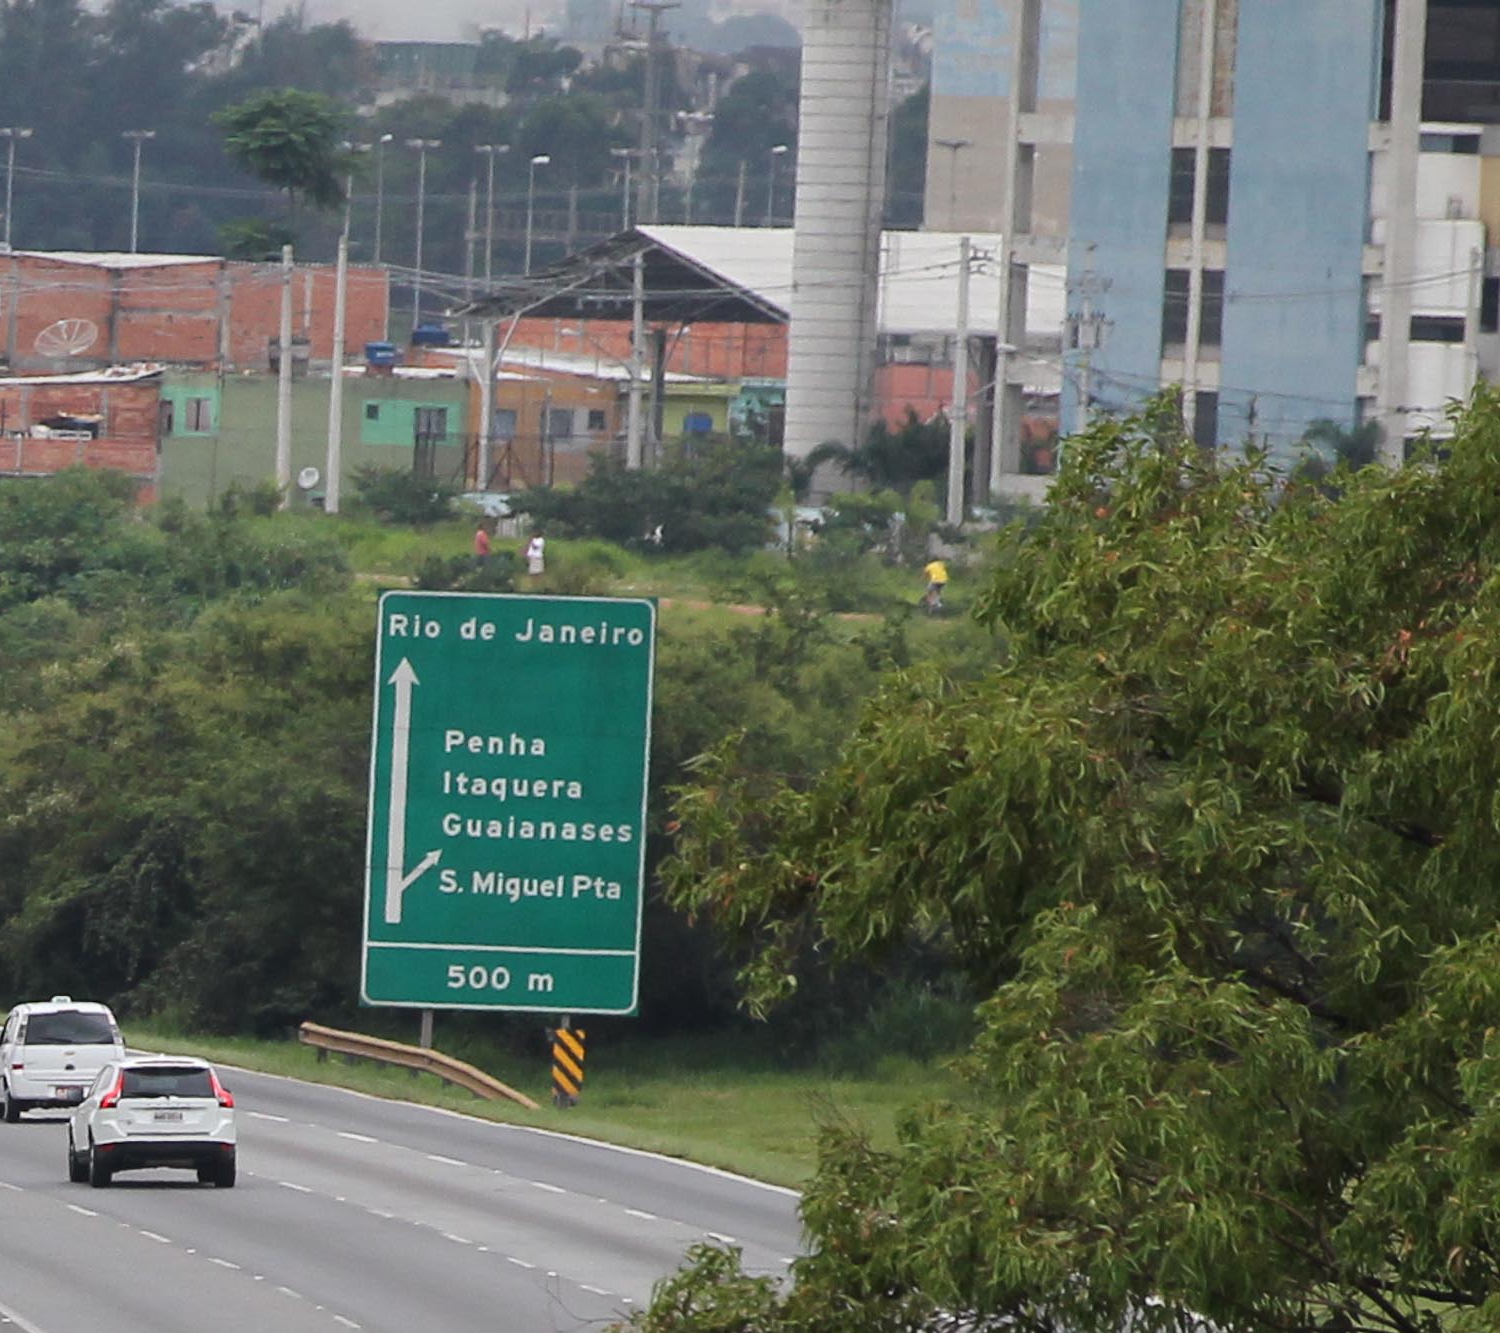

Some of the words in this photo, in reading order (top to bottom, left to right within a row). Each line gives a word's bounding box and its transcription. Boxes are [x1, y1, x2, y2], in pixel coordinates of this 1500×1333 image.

[389, 614, 441, 638] Rio
[459, 617, 497, 641] de
[515, 618, 645, 646] Janeiro
[444, 730, 546, 756] Penha
[443, 771, 583, 802] Itaquera
[442, 813, 633, 842] Guaianases
[438, 870, 464, 894] S.
[472, 872, 564, 903] Miguel
[571, 875, 622, 900] Pta
[447, 965, 511, 990] 500
[527, 973, 554, 992] m
